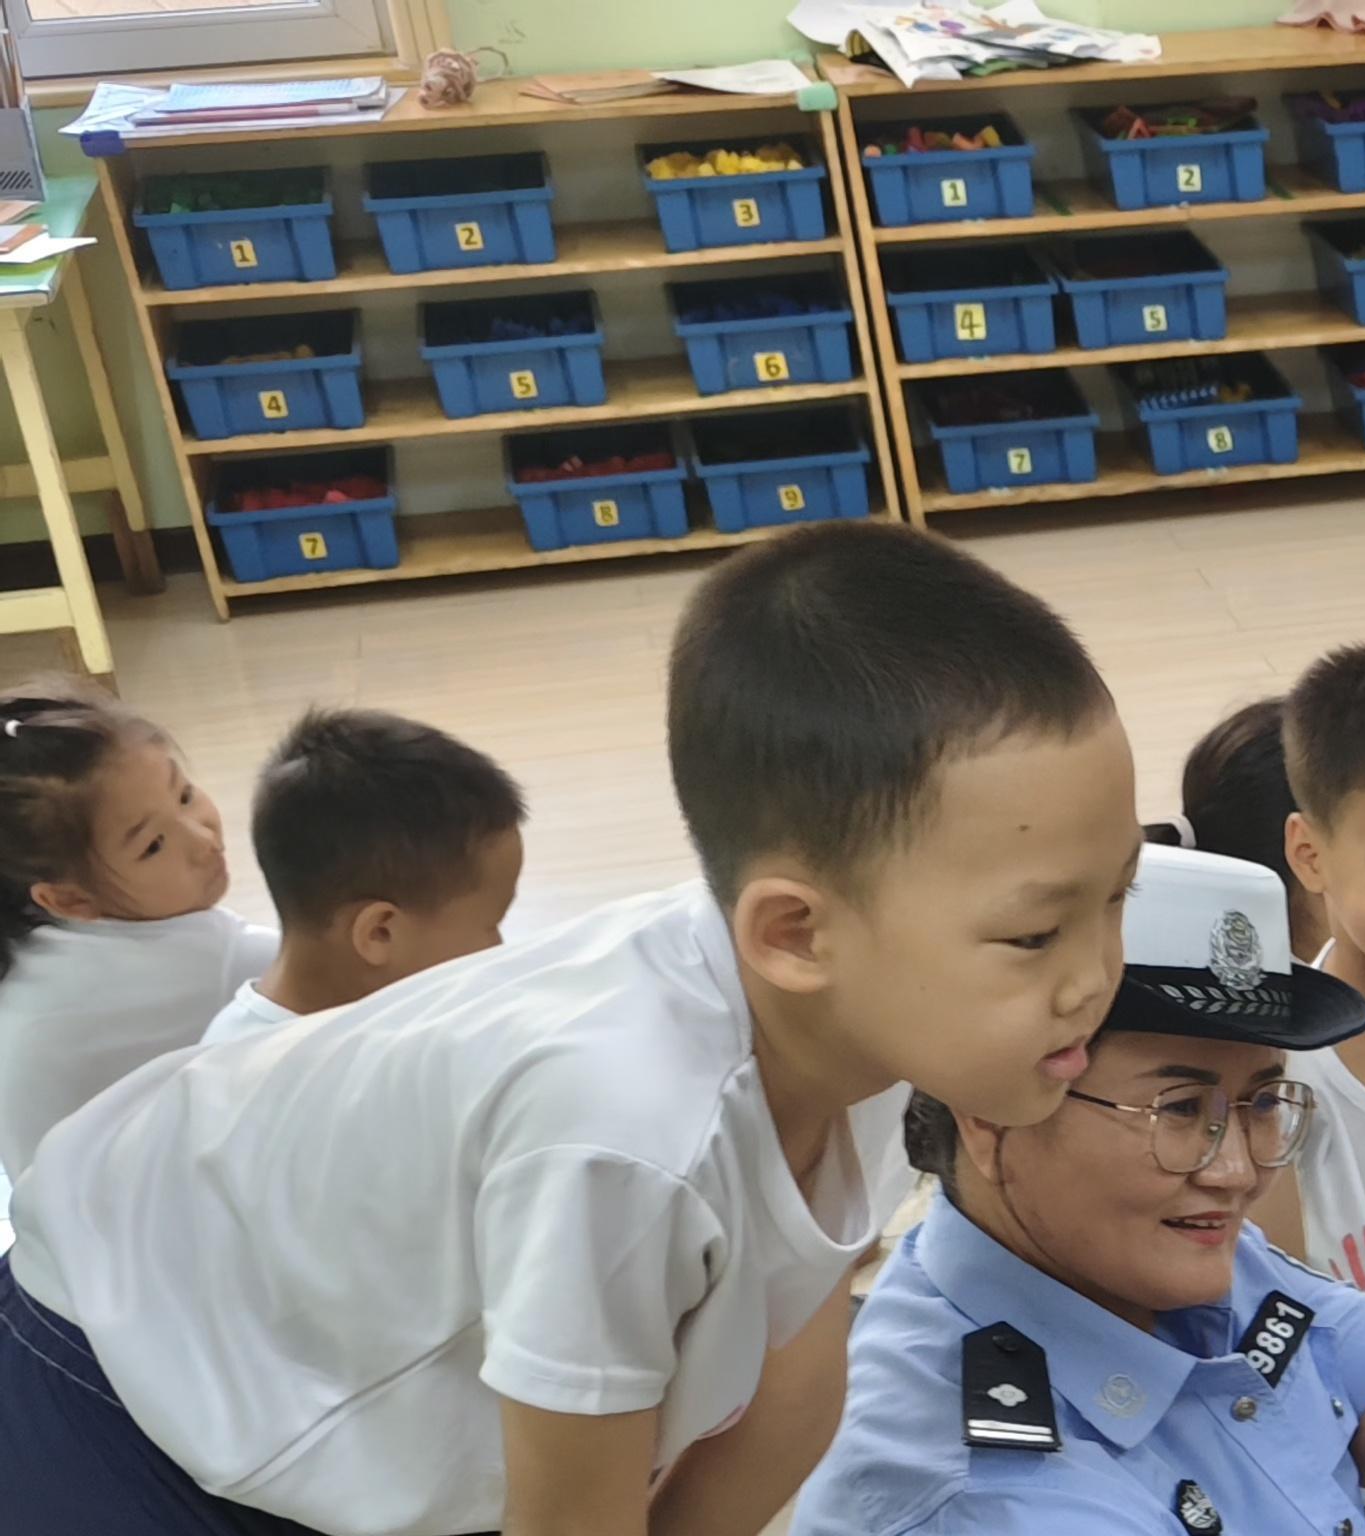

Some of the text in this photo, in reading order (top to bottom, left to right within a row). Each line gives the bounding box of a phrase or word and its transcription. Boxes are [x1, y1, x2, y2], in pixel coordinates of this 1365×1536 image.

[1183, 168, 1194, 186] 2
[949, 183, 961, 202] 1
[738, 204, 753, 223] 3
[461, 227, 478, 246] 2
[235, 244, 251, 263] 1
[960, 310, 981, 338] 4
[1150, 310, 1161, 329] 5
[764, 356, 781, 377] 6
[517, 376, 532, 395] 5
[268, 396, 282, 412] 4
[1215, 432, 1227, 450] 8
[1013, 454, 1025, 471] 7
[784, 489, 798, 507] 9
[600, 506, 614, 523] 8
[304, 538, 319, 556] 7
[1247, 1301, 1305, 1374] 9861
